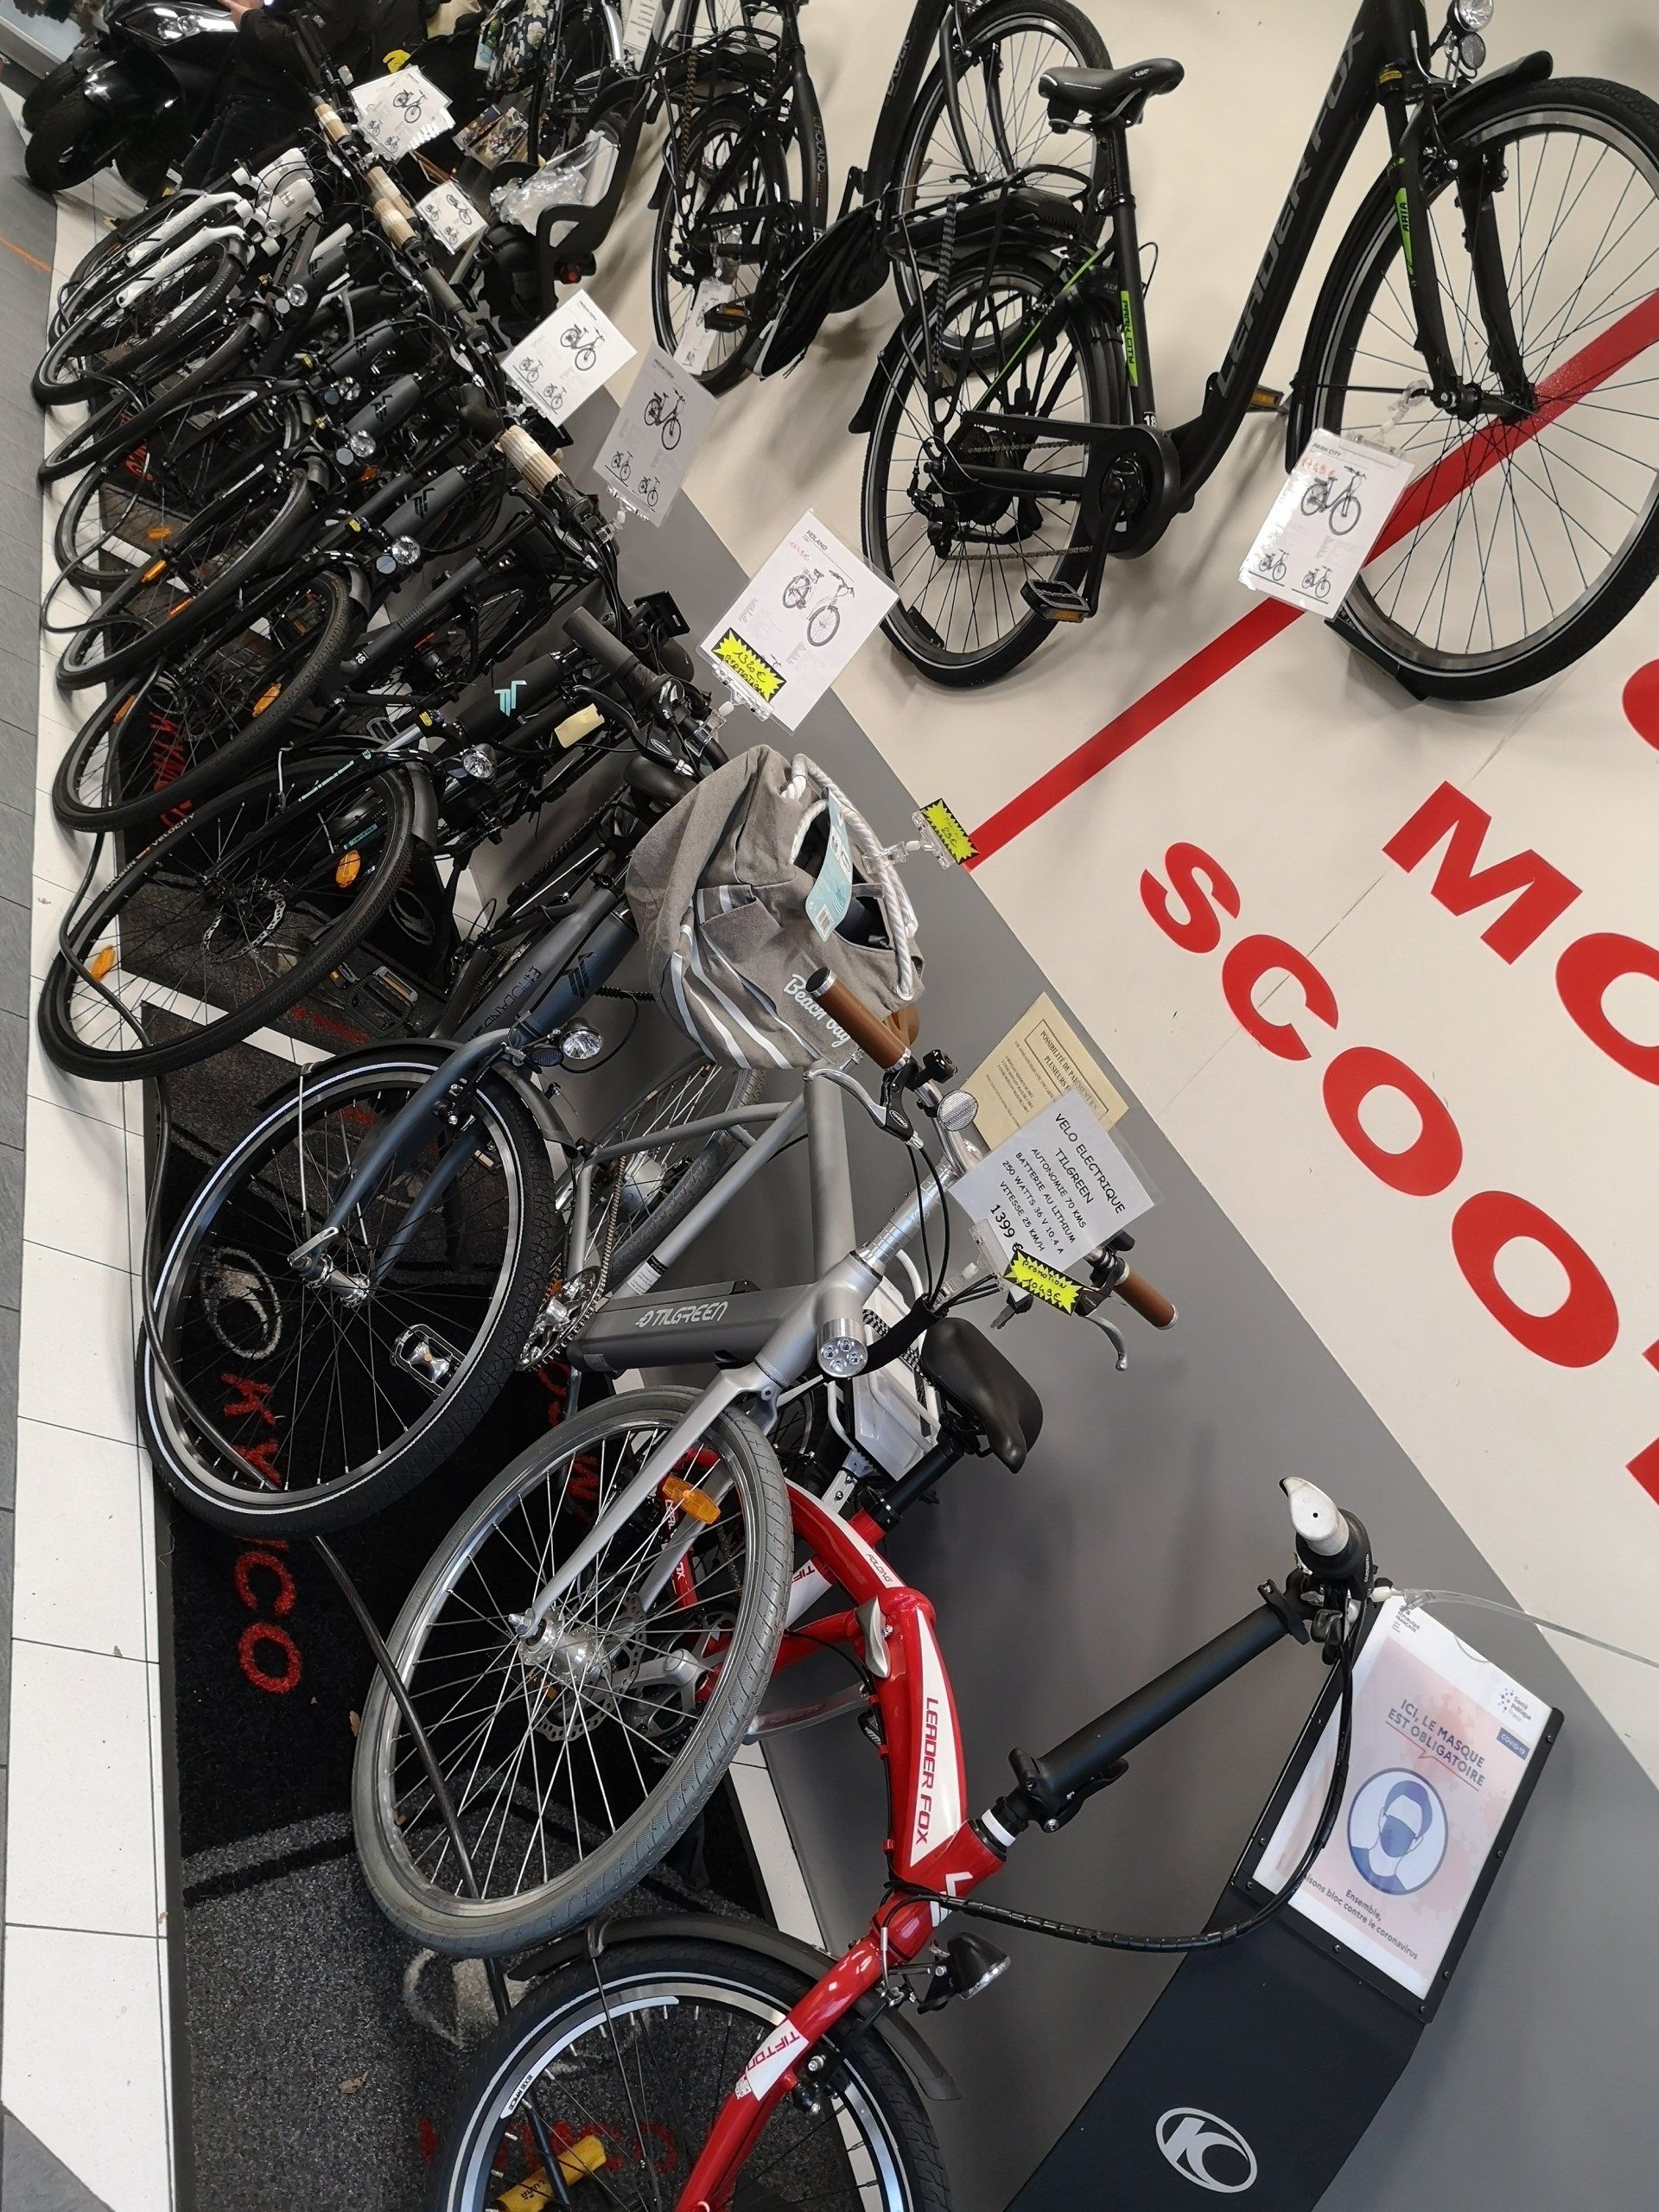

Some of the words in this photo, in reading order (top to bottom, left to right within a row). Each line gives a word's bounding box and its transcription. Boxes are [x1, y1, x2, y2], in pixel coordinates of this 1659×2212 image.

[1144, 414, 1157, 426] 18
[805, 530, 828, 551] HOLAND
[355, 652, 366, 664] 18
[152, 812, 194, 846] VELOCITY
[1040, 1030, 1066, 1065] POSSIBILITÉ
[1062, 1062, 1071, 1074] DE
[1044, 1055, 1066, 1087] PLUSIEURS
[1031, 1147, 1067, 1198] AUTONOMIE
[1065, 1198, 1075, 1210] 70
[1072, 1209, 1087, 1230] KMS
[1054, 1113, 1078, 1142] VELO
[1075, 1143, 1126, 1215] ELECTRIQUE
[1054, 1147, 1095, 1205] TILGREEN
[1140, 842, 1659, 1509] SCOO
[990, 1205, 1015, 1239] 1399
[1000, 1180, 1028, 1217] VITESSE
[1022, 1218, 1032, 1229] 25
[1028, 1229, 1046, 1252] KM/H
[1002, 1160, 1015, 1176] 250
[1014, 1176, 1036, 1206] WATTS
[1033, 1206, 1043, 1218] 36
[1045, 1227, 1059, 1246] 10.4
[1015, 1152, 1045, 1192] BATTERIE
[1043, 1192, 1053, 1205] AU
[1051, 1205, 1077, 1244] LITHIUM
[652, 1300, 728, 1327] TILGREEN
[865, 1554, 893, 1583] FOLDING
[921, 1696, 939, 1790] LEADER
[1388, 1708, 1411, 1728] EST
[1411, 1726, 1485, 1787] OBLIGATOIRE
[1401, 1699, 1420, 1722] ICI,
[1421, 1715, 1436, 1732] LE
[1438, 1726, 1484, 1768] MASQUE
[916, 1793, 933, 1846] FOX
[1325, 1888, 1344, 1906] bloc
[1343, 1903, 1368, 1923] contre
[1368, 1918, 1376, 1929] le
[1376, 1925, 1418, 1960] coronavirus
[1345, 1889, 1382, 1922] Ensemble,
